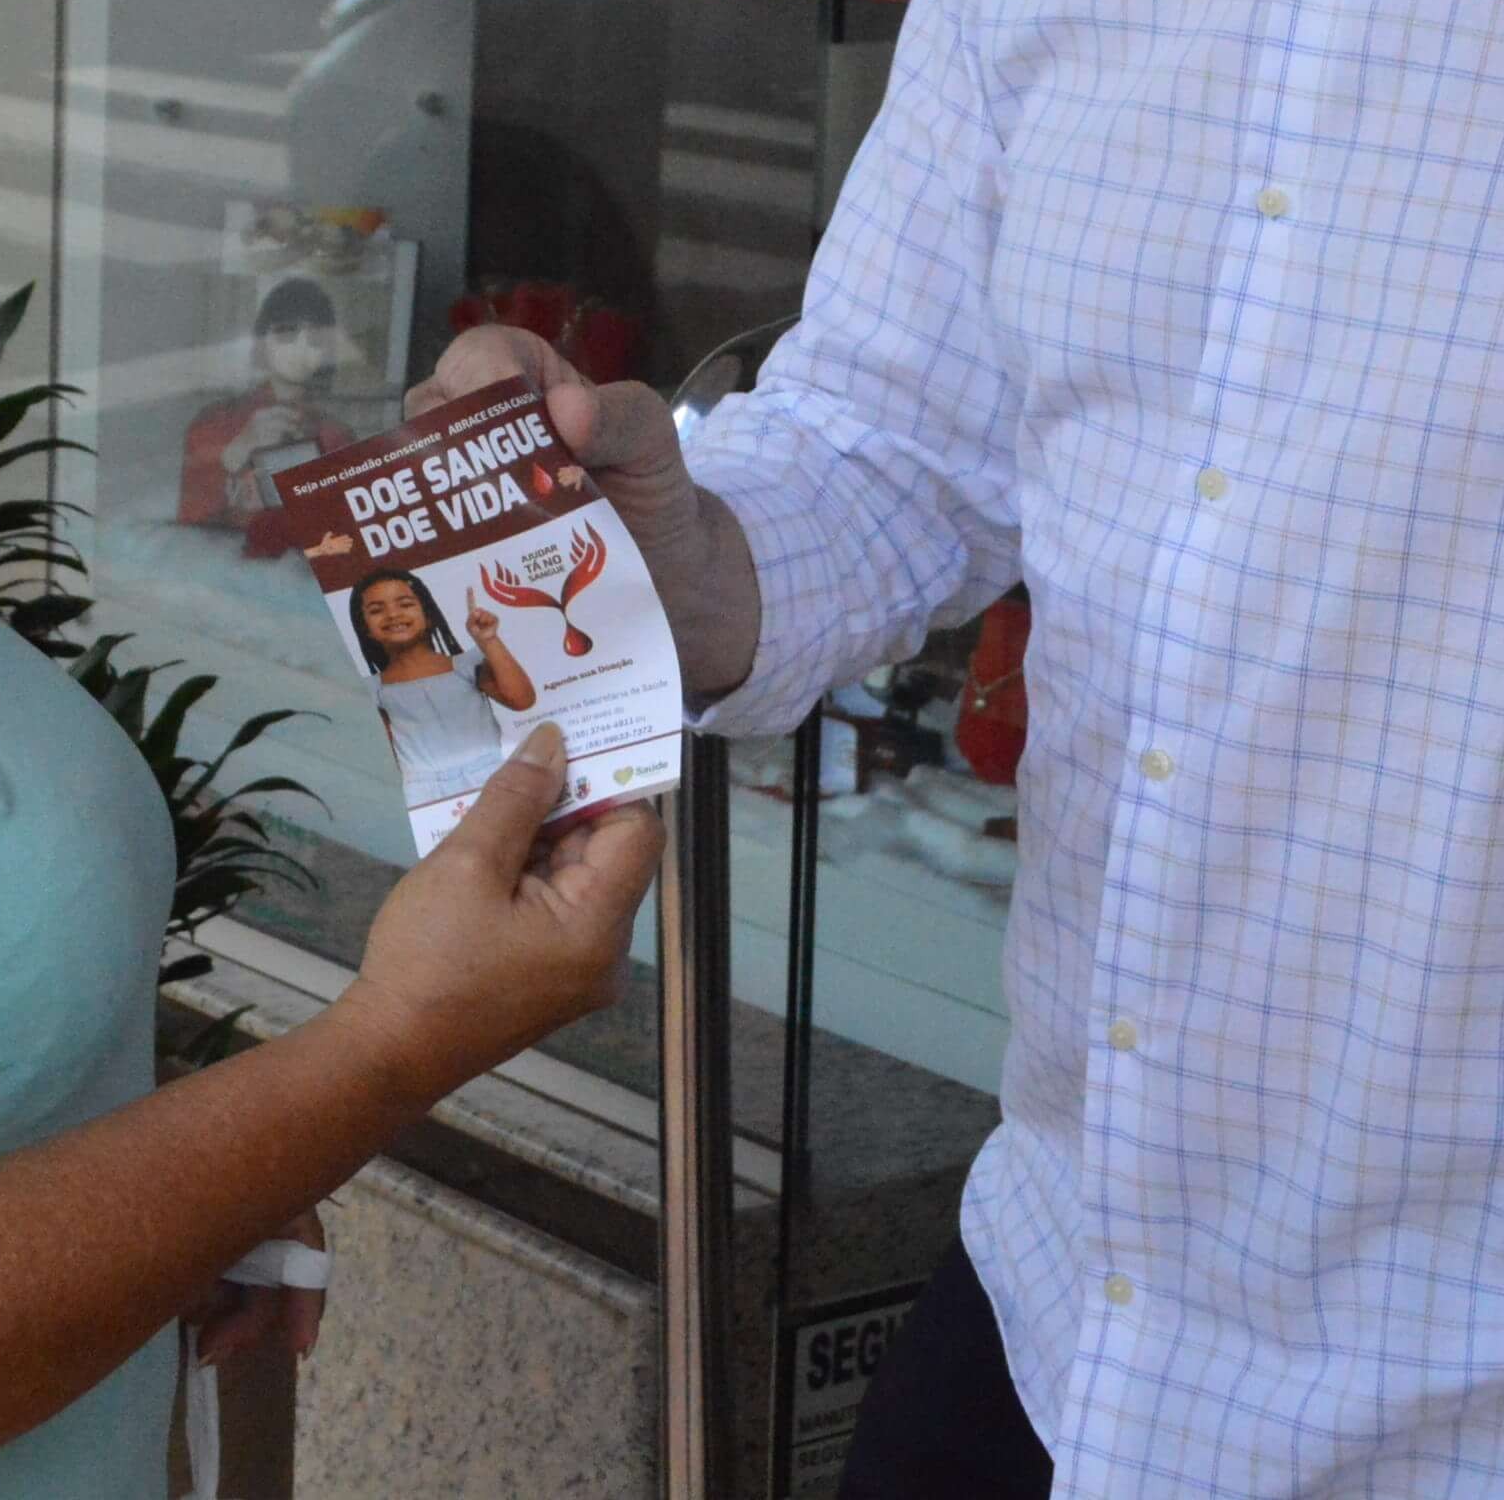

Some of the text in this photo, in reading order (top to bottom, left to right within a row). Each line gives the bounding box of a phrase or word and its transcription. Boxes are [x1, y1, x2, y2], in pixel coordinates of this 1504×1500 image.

[293, 480, 319, 497] Seja
[319, 475, 338, 488] um
[339, 458, 383, 481] cidadão
[383, 432, 442, 463] consciente
[447, 410, 488, 436] ABRACE
[487, 402, 512, 418] ESSA
[344, 412, 553, 522] DOE SANGUE
[359, 472, 529, 558] DOE VIDA
[521, 543, 558, 563] AJUDAR
[524, 553, 562, 574] TÁ NO
[528, 564, 566, 582] SANGUE
[579, 668, 598, 679] sua
[597, 657, 634, 675] Doação
[635, 760, 669, 776] Saúde
